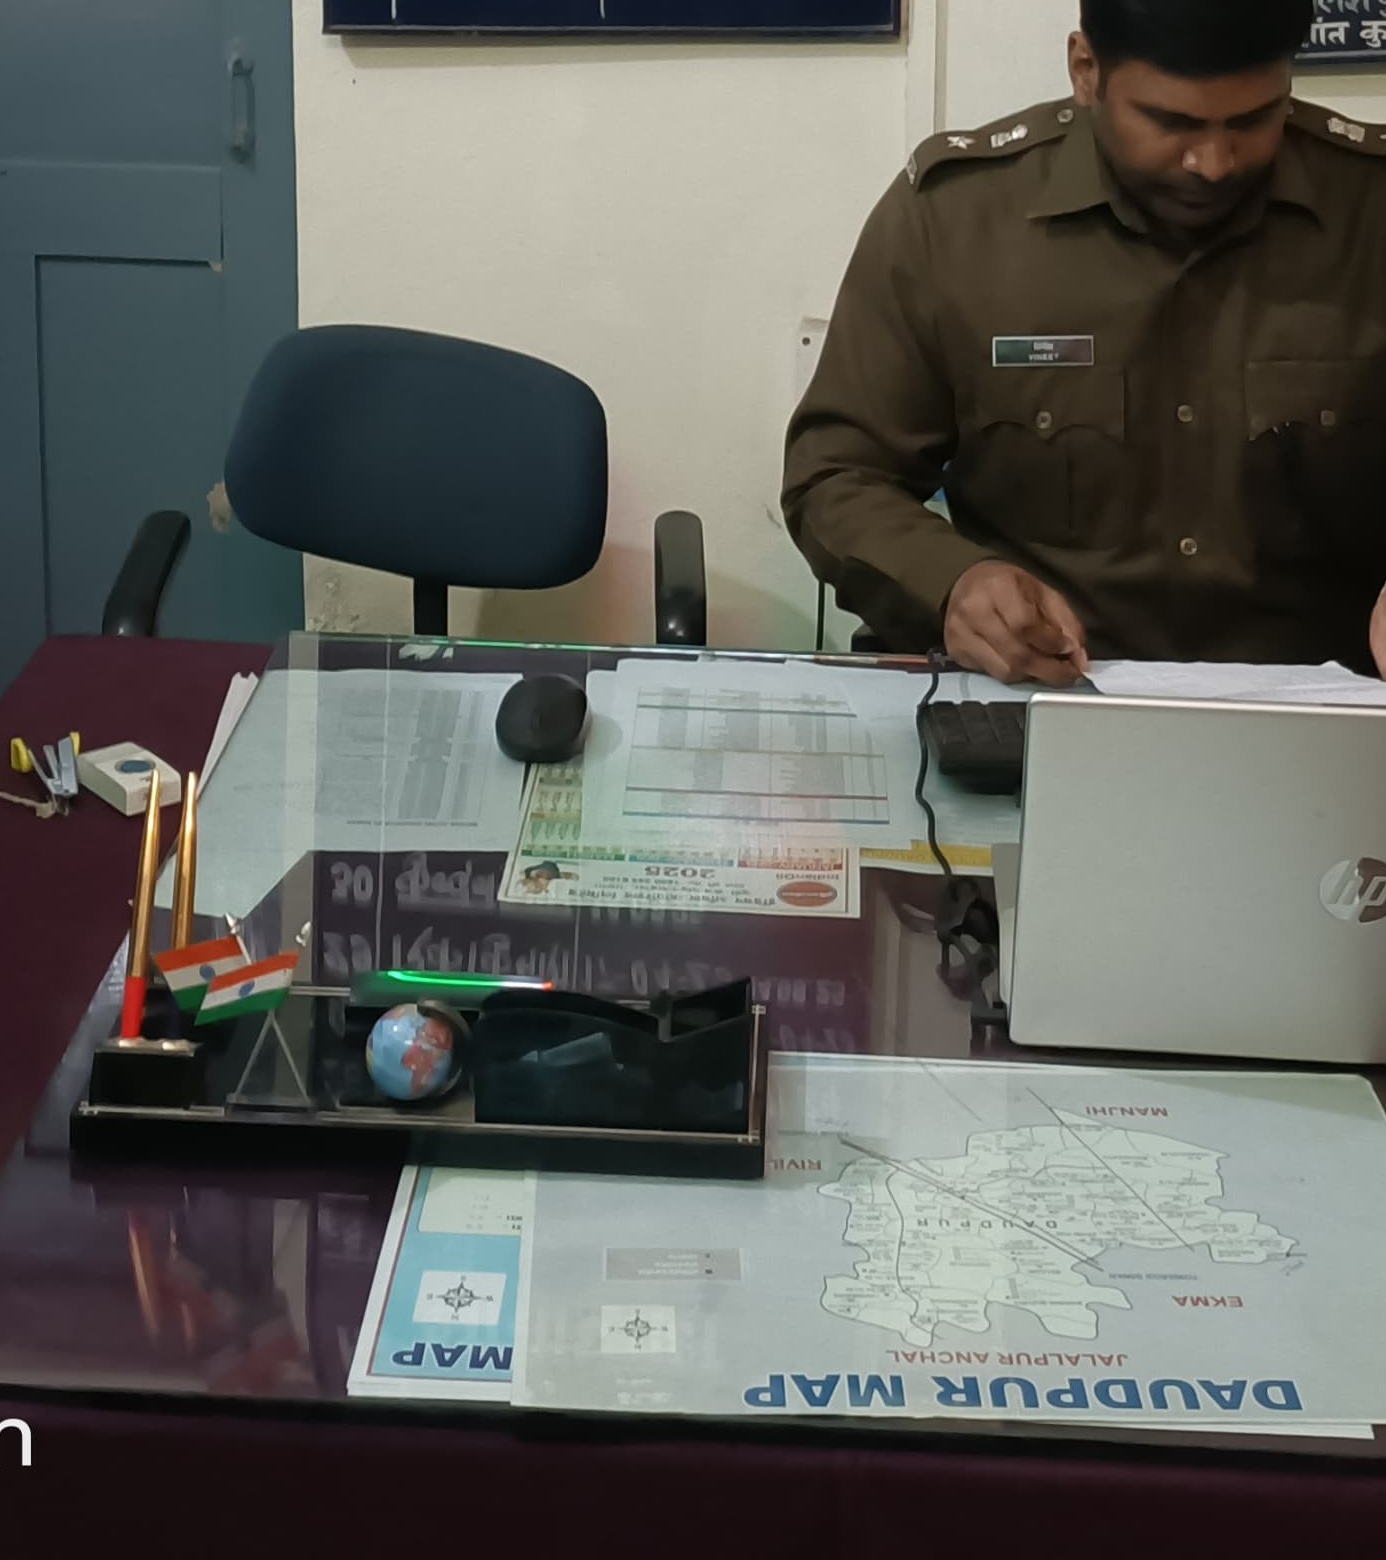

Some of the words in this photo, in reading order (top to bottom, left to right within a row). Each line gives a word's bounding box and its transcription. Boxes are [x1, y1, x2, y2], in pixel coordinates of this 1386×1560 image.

[1085, 1105, 1168, 1118] MANJHI
[1172, 1294, 1245, 1308] EKMA
[392, 1342, 513, 1372] MAP
[885, 1348, 993, 1366] ANCHAL
[997, 1351, 1130, 1367] JALALPUR
[743, 1374, 907, 1408] MAP
[935, 1374, 1303, 1411] DAUDPUR
